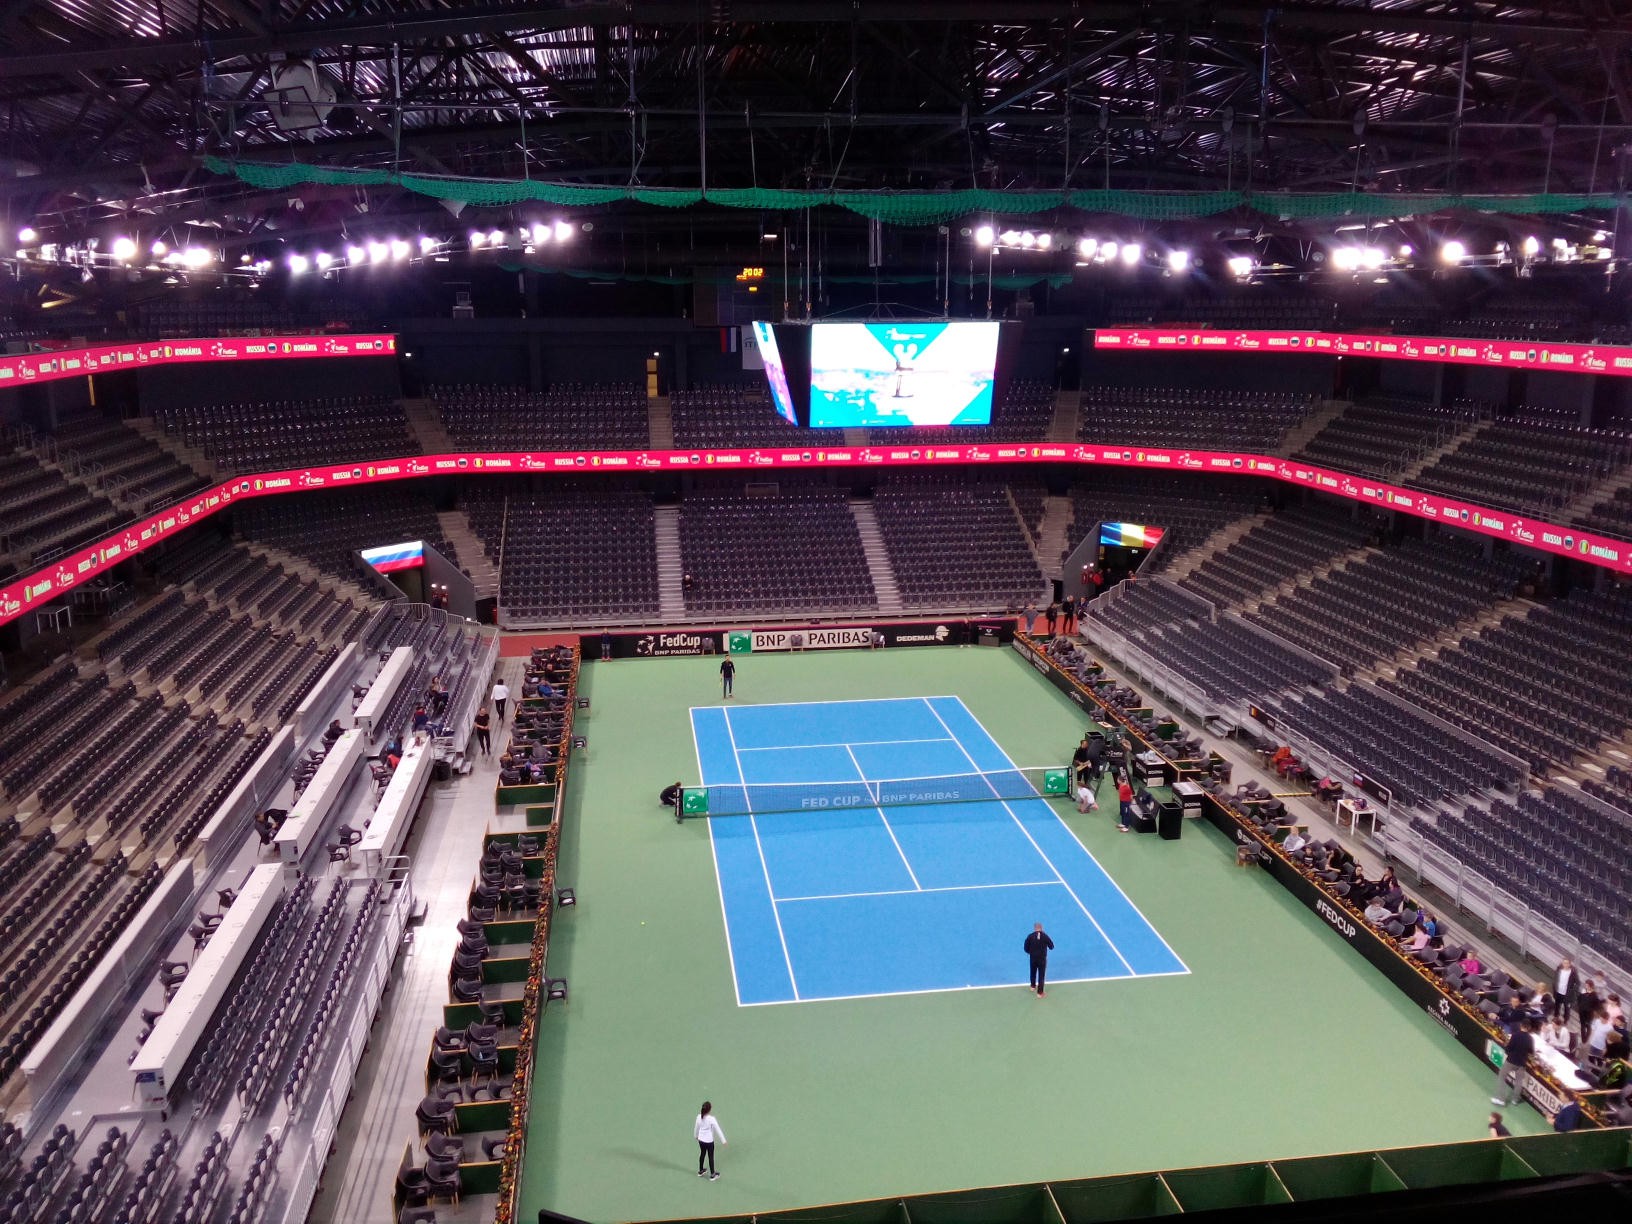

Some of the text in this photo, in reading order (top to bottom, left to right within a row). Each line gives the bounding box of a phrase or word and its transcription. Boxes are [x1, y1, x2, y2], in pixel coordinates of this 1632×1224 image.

[660, 634, 700, 648] FedCup
[756, 631, 870, 646] BNP PARIBAS
[802, 798, 829, 808] FED
[832, 796, 860, 806] CUP
[882, 795, 906, 803] BNP
[909, 791, 959, 800] PARIBAS
[1316, 899, 1356, 937] #FEDCUP
